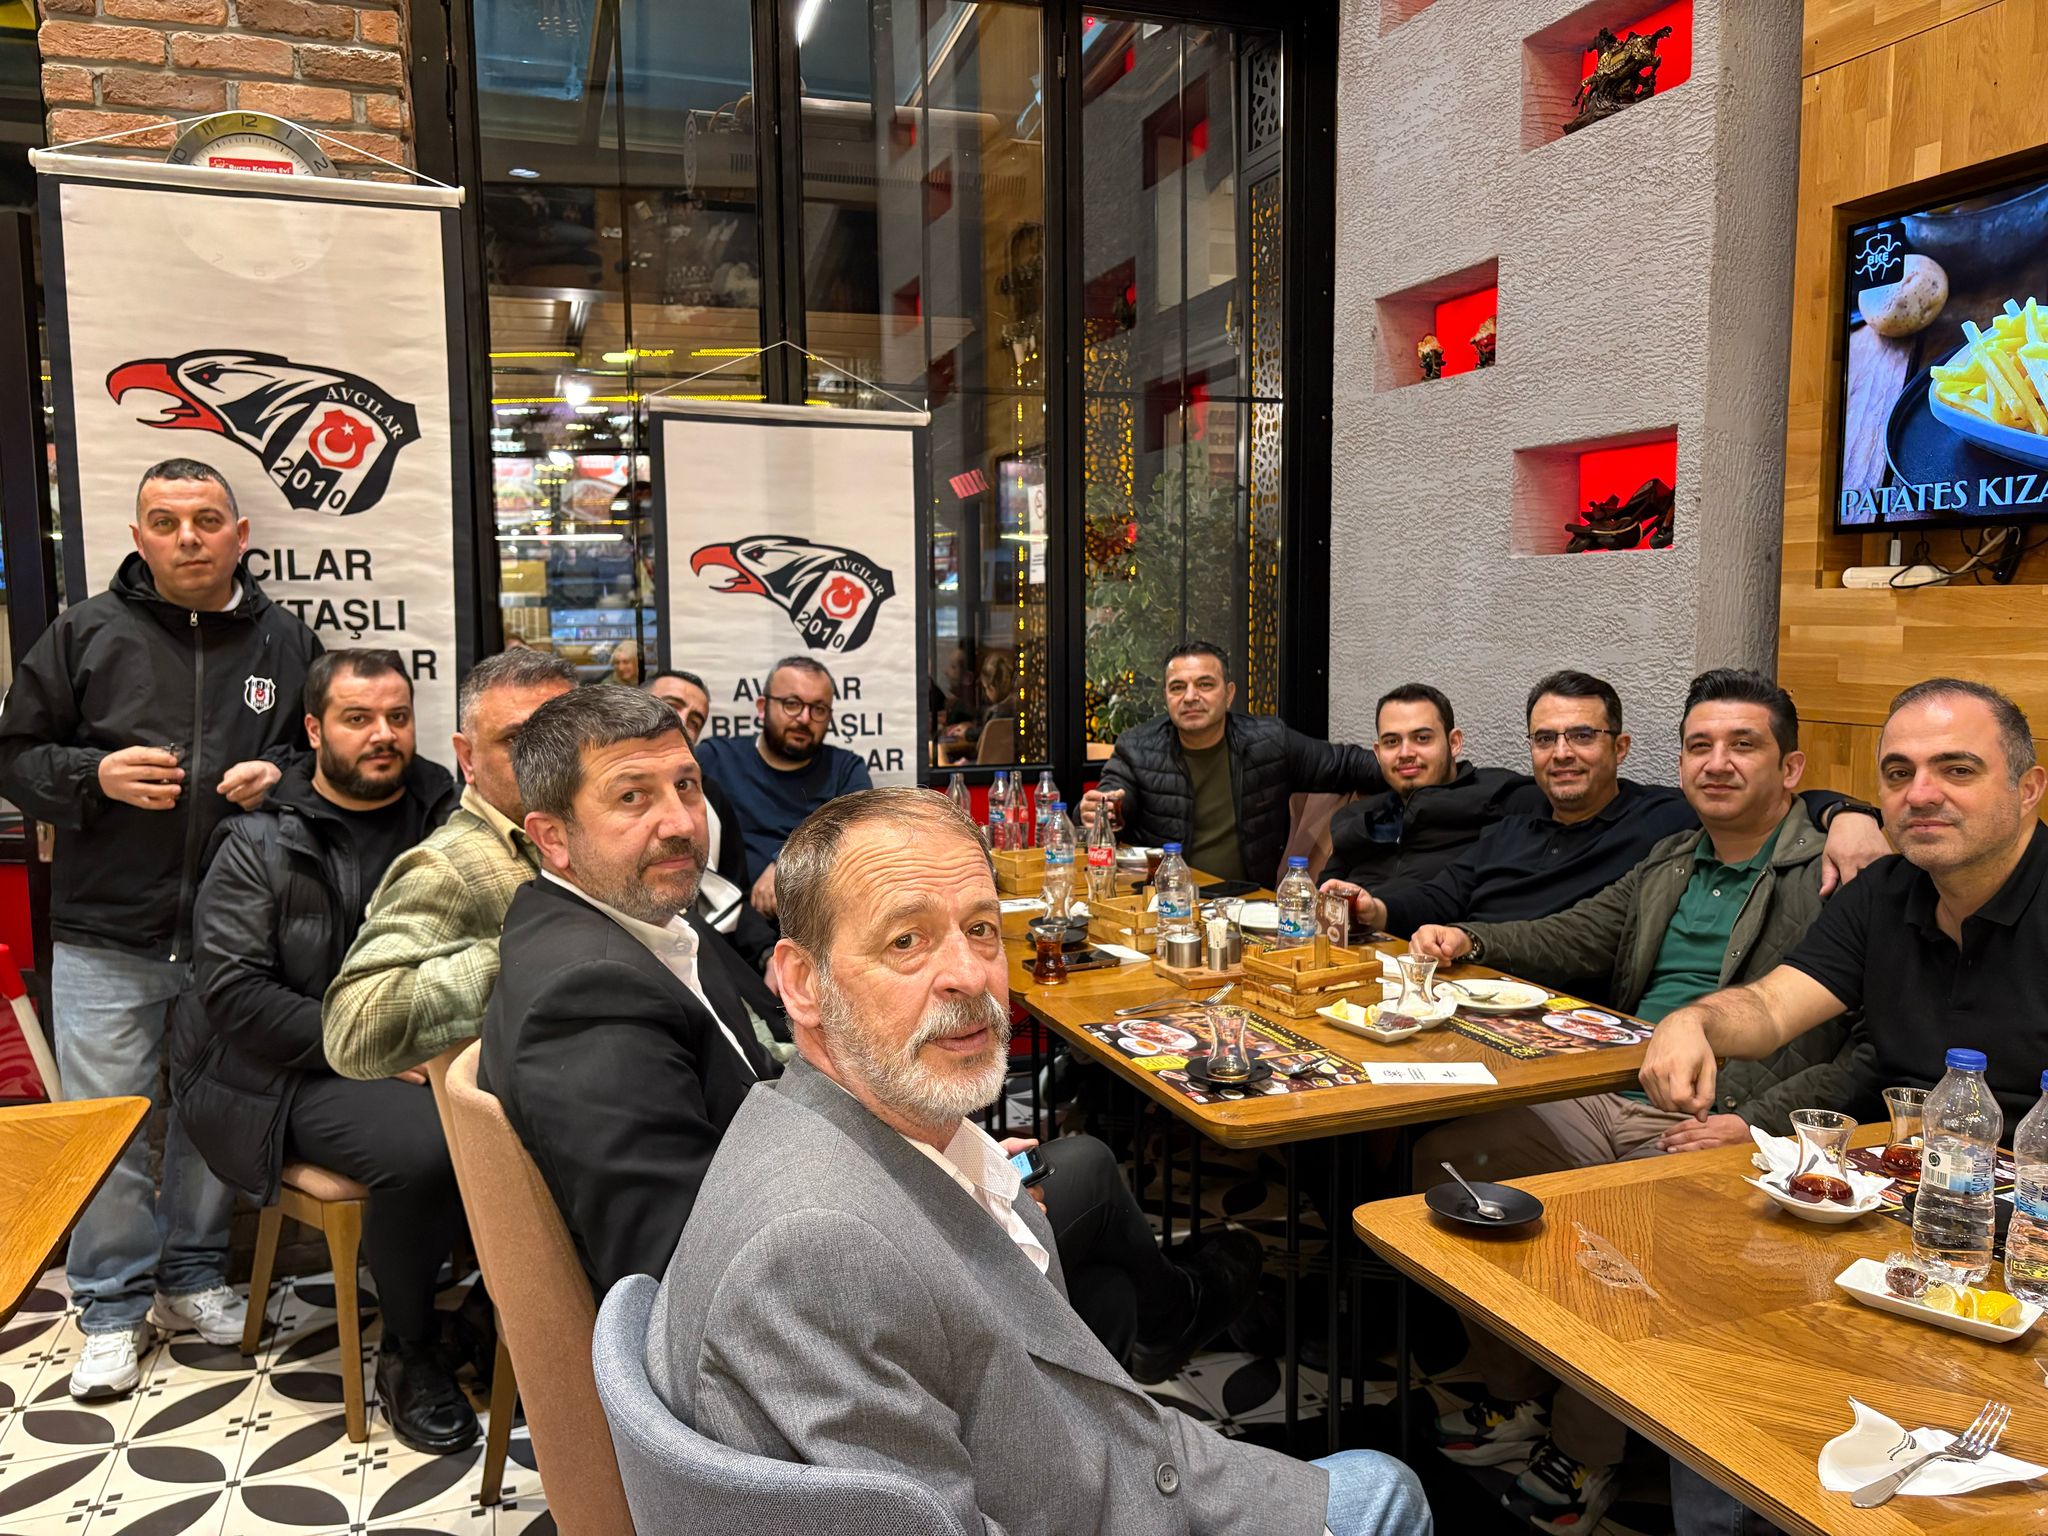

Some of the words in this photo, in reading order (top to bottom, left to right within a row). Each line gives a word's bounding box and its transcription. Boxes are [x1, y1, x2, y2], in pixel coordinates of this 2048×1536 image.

[241, 115, 258, 128] 12
[1867, 252, 1889, 265] BKE
[325, 386, 404, 441] AVCILAR
[272, 456, 347, 509] 2010
[1841, 479, 1968, 517] PATATES
[240, 548, 373, 582] CILAR
[832, 559, 885, 597] AVCILAR
[280, 599, 406, 640] TAŞLI
[796, 610, 845, 649] 2010
[1971, 1157, 1991, 1192] SAPANCA
[2018, 1177, 2040, 1217] SAPANCA
